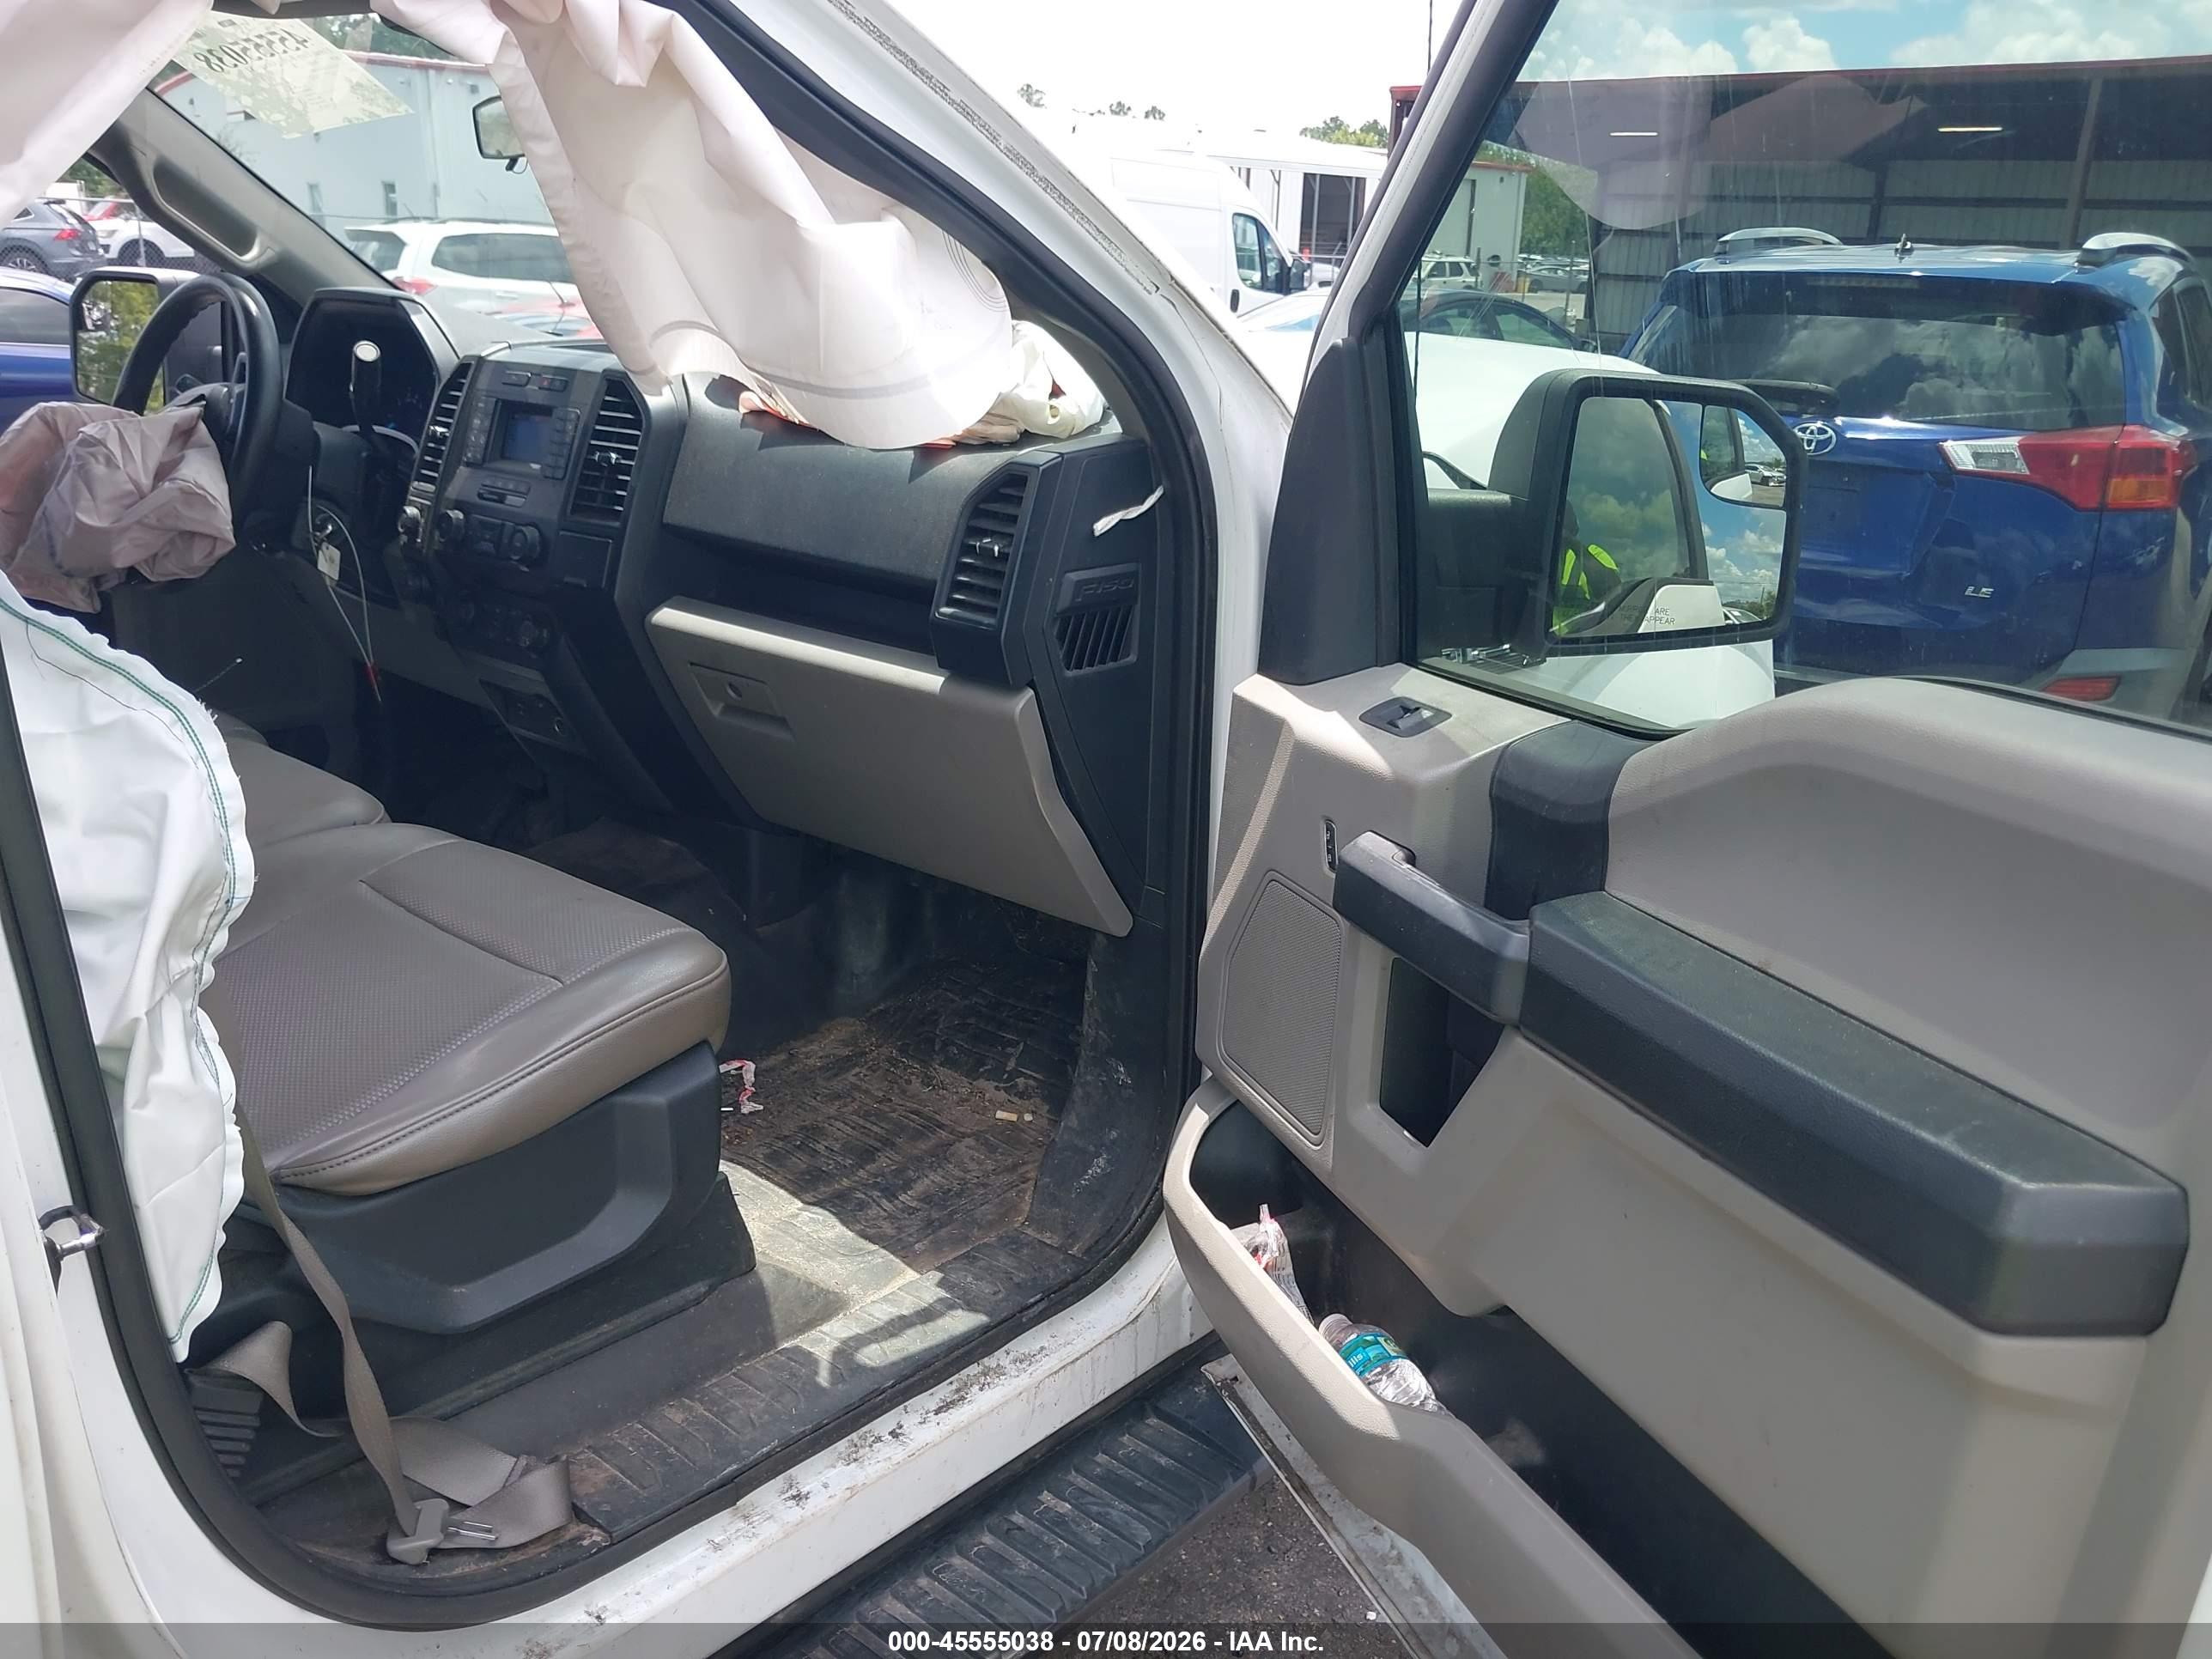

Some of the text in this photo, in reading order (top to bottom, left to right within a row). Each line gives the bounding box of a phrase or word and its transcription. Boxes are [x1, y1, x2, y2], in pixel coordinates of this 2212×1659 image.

[1964, 586, 1994, 599] LE
[1654, 607, 1670, 617] ARE
[1644, 616, 1675, 626] APPEAR
